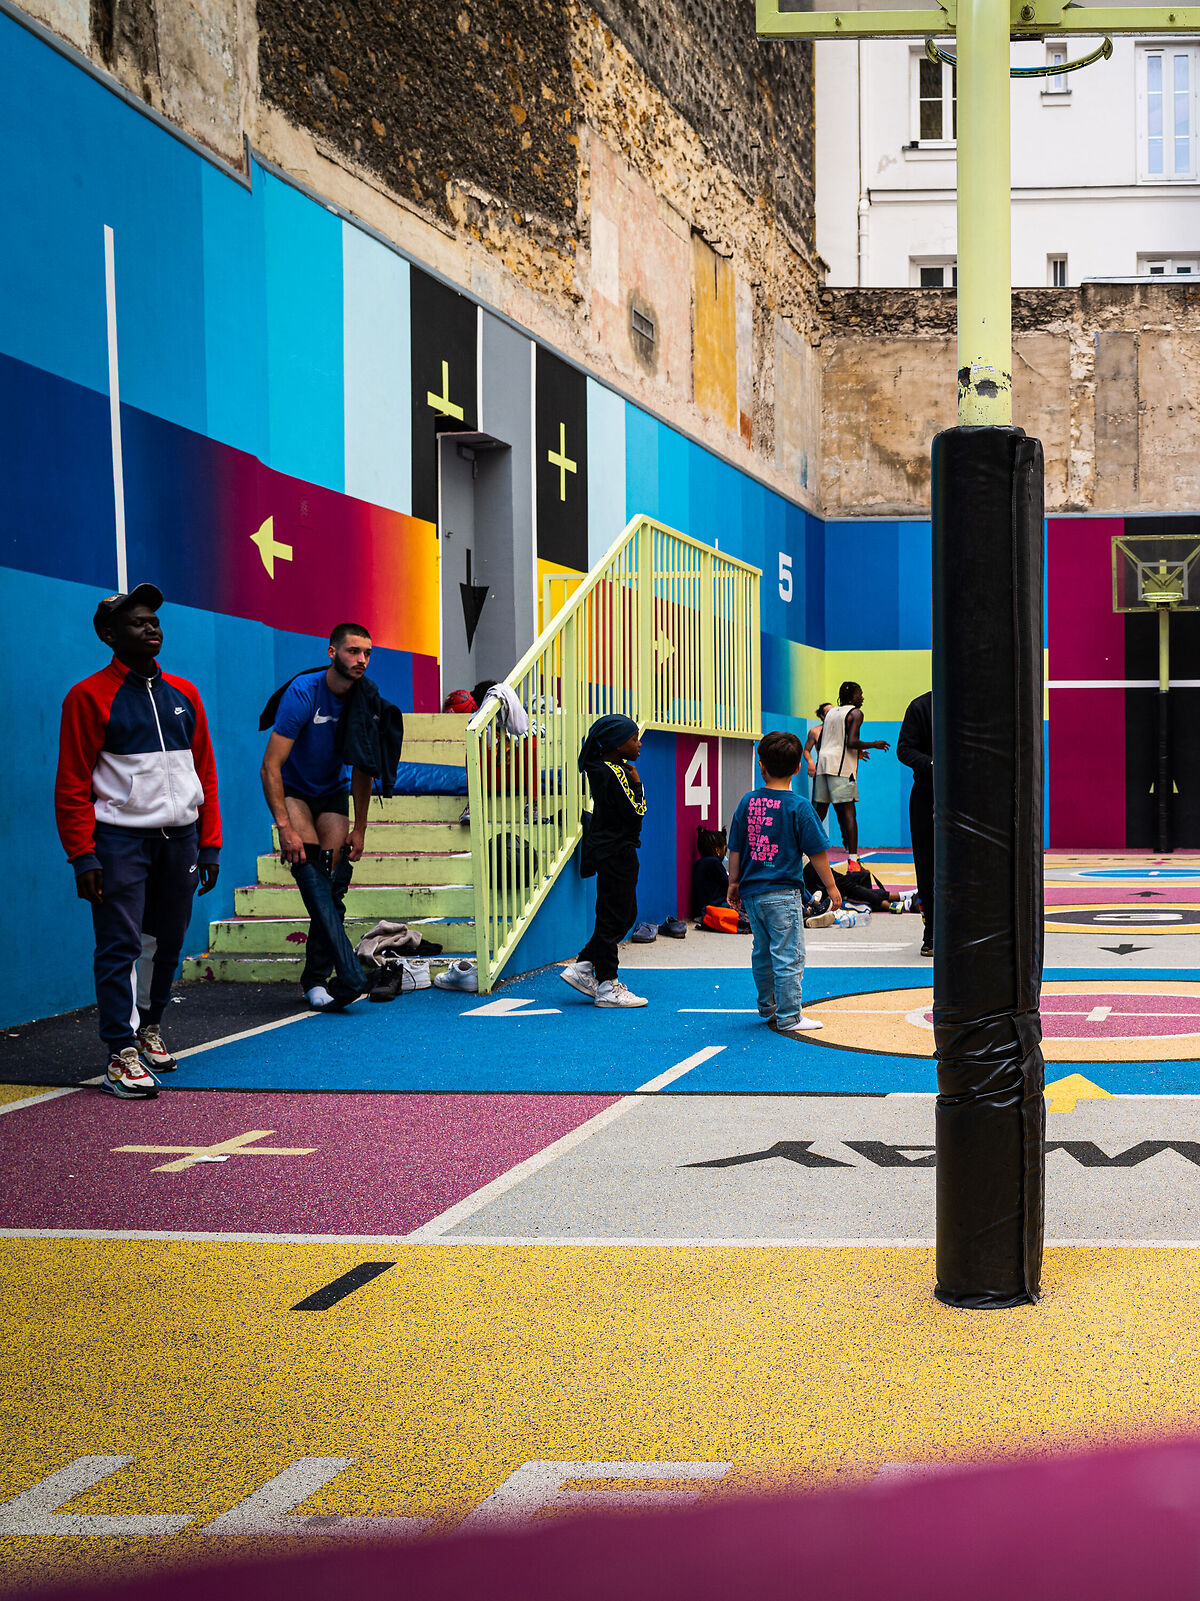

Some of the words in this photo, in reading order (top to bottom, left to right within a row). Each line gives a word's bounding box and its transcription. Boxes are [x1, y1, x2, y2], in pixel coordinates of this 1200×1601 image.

[778, 551, 793, 603] 5
[684, 742, 711, 821] 4
[749, 797, 781, 809] CATCH
